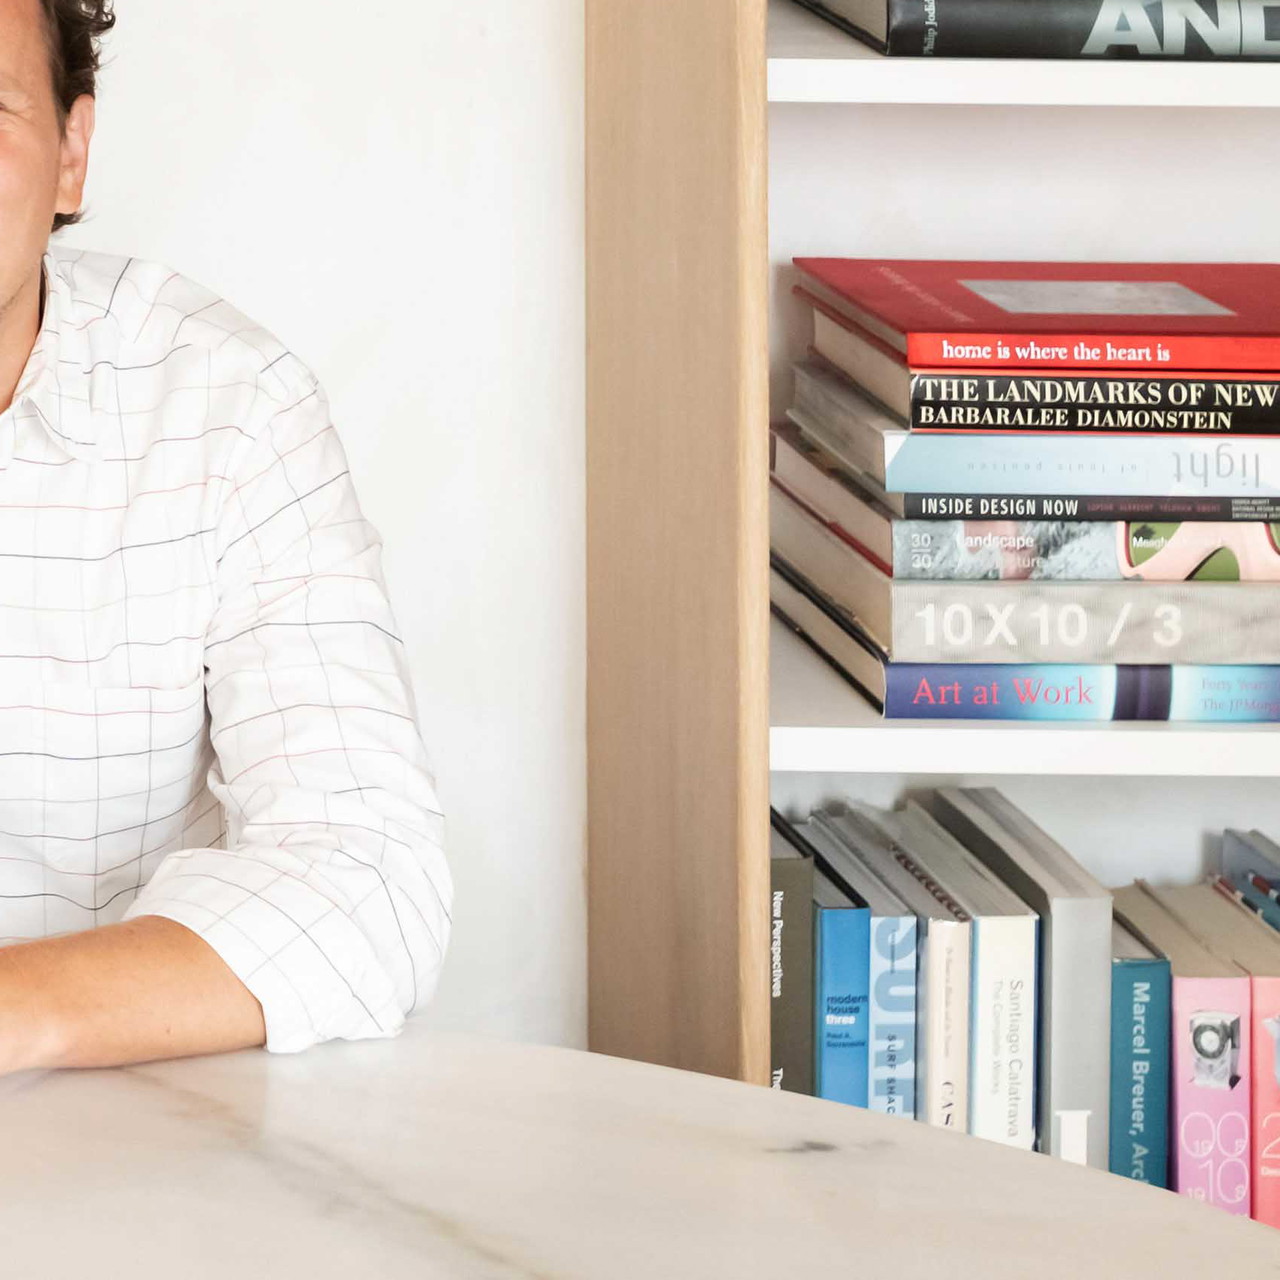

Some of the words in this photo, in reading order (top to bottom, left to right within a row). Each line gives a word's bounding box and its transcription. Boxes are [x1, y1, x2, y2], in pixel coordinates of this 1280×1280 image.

[942, 340, 991, 359] home
[997, 341, 1011, 359] is
[1015, 342, 1068, 360] where
[1073, 343, 1101, 360] the
[1106, 344, 1152, 361] heart
[1156, 343, 1170, 361] is
[919, 378, 980, 402] THE
[985, 379, 1162, 405] LANDMARKS
[1167, 383, 1206, 405] OF
[1214, 384, 1280, 407] NEW
[919, 406, 1069, 426] BARBARALEE
[1077, 410, 1232, 429] DIAMONSTEIN
[921, 498, 974, 515] INSIDE
[980, 498, 1036, 515] DESIGN
[1043, 499, 1078, 516] NOW
[910, 533, 931, 548] 30
[956, 533, 1035, 550] Landscape
[910, 553, 932, 569] 30
[915, 603, 972, 646] 10
[984, 604, 1018, 646] X
[1030, 603, 1088, 647] 10
[1153, 604, 1183, 647] 3
[912, 677, 961, 705] Art
[973, 682, 1000, 705] at
[1012, 675, 1095, 705] Work
[1201, 698, 1225, 710] The
[772, 890, 784, 919] New
[772, 919, 784, 998] Perspectives
[1008, 978, 1023, 1054] Santiago
[1132, 981, 1151, 1054] Marcel
[887, 1034, 896, 1070] SURF
[1007, 1058, 1023, 1138] Calatrava
[1128, 1060, 1150, 1136] Breuer,
